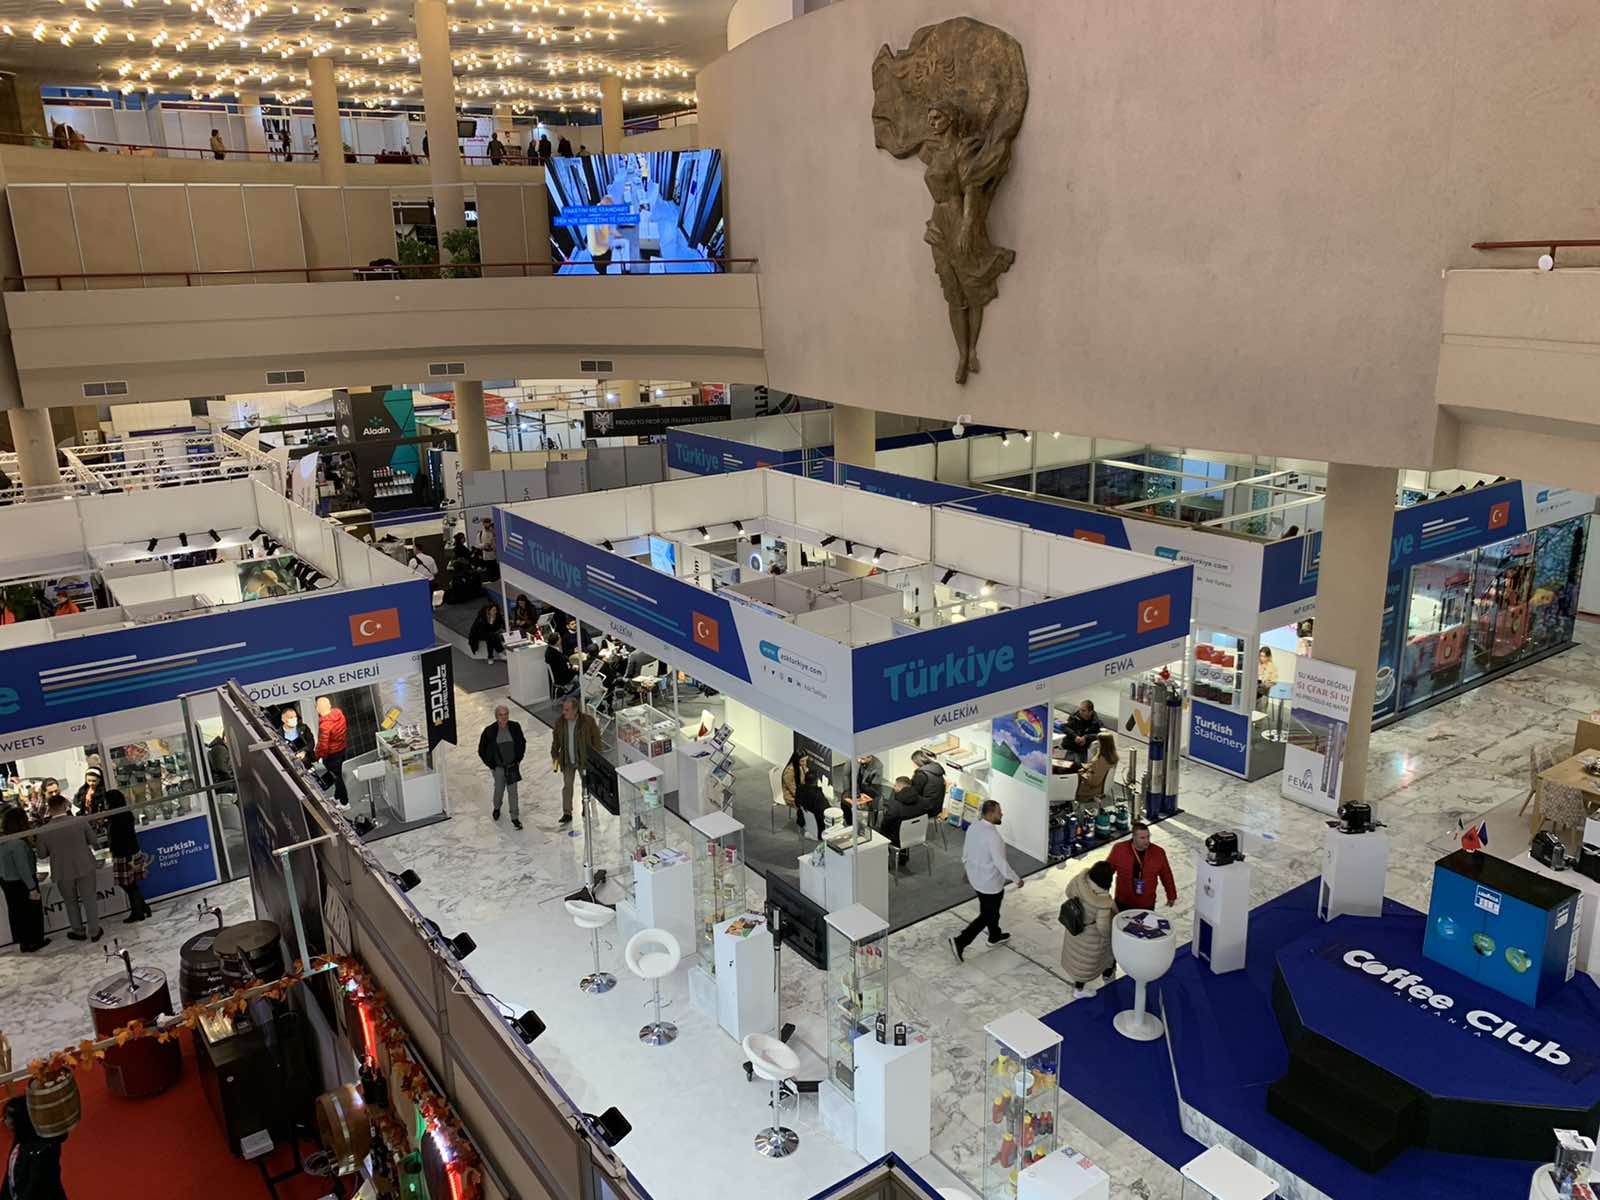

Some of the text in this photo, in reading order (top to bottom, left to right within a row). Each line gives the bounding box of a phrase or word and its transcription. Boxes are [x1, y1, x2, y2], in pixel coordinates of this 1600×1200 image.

[363, 427, 390, 436] Aladin
[674, 442, 719, 473] Türkiye
[527, 539, 582, 590] Türkiye
[883, 644, 1015, 703] Türkiye
[1104, 656, 1135, 677] FEWA
[249, 665, 380, 702] ÖDÜL SOLAR ENERJİ
[933, 704, 980, 727] KALEKİM
[1194, 715, 1233, 736] Turkish
[1194, 725, 1246, 753] Stationery
[1287, 774, 1313, 792] FEWA
[157, 839, 196, 855] Turkish
[159, 851, 180, 862] Dried
[159, 860, 178, 868] Nuts
[1343, 950, 1572, 1067] Coffee Club
[1393, 991, 1482, 1038] ALBANIA
